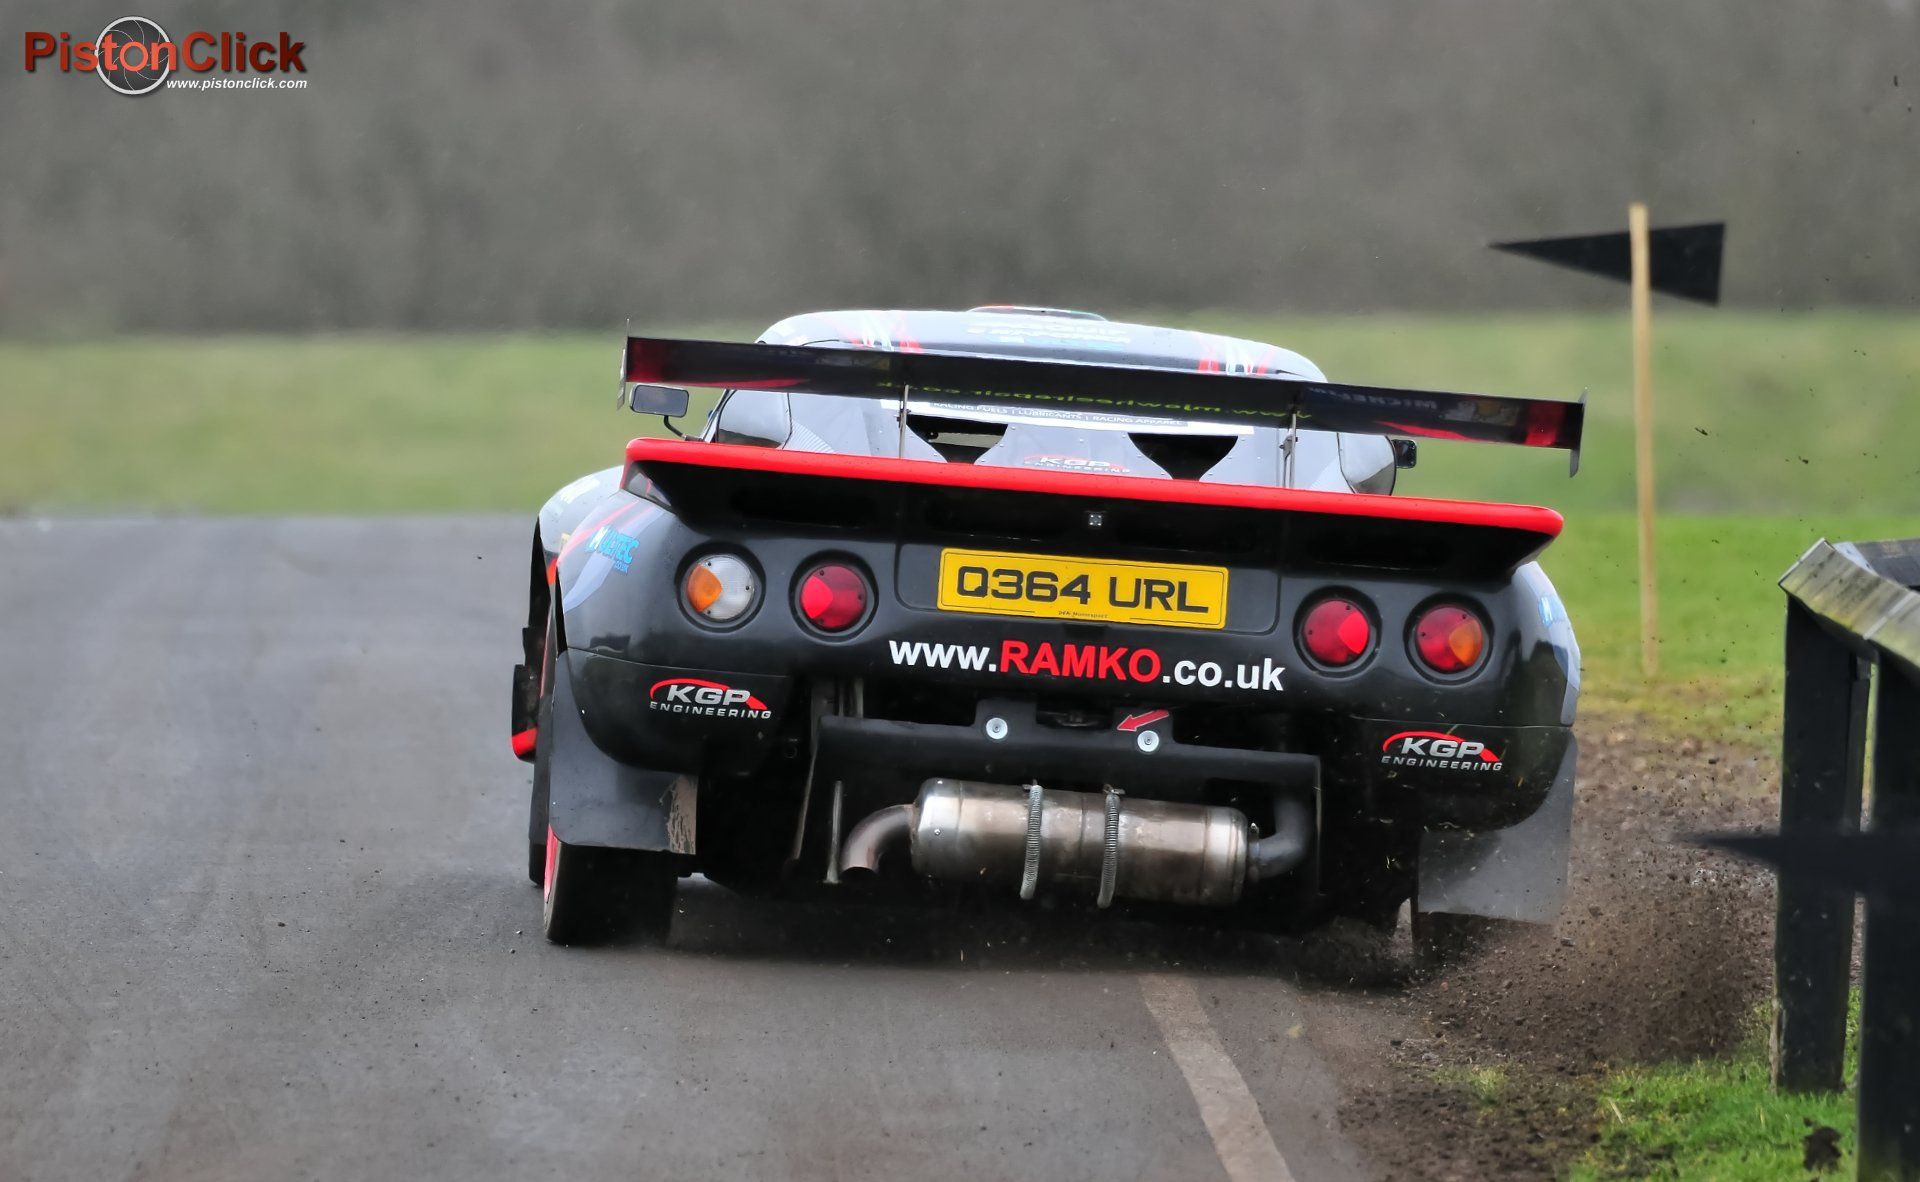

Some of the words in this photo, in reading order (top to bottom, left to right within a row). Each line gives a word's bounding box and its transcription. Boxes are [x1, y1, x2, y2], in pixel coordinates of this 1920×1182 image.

[955, 566, 1091, 605] Q364
[1108, 576, 1209, 613] URL
[888, 639, 1286, 692] www.RAMKO.co.uk
[666, 684, 751, 706] KGP
[649, 701, 772, 719] ENGINEERING
[1400, 737, 1485, 759] KGP
[1381, 755, 1503, 771] ENGINEERING
